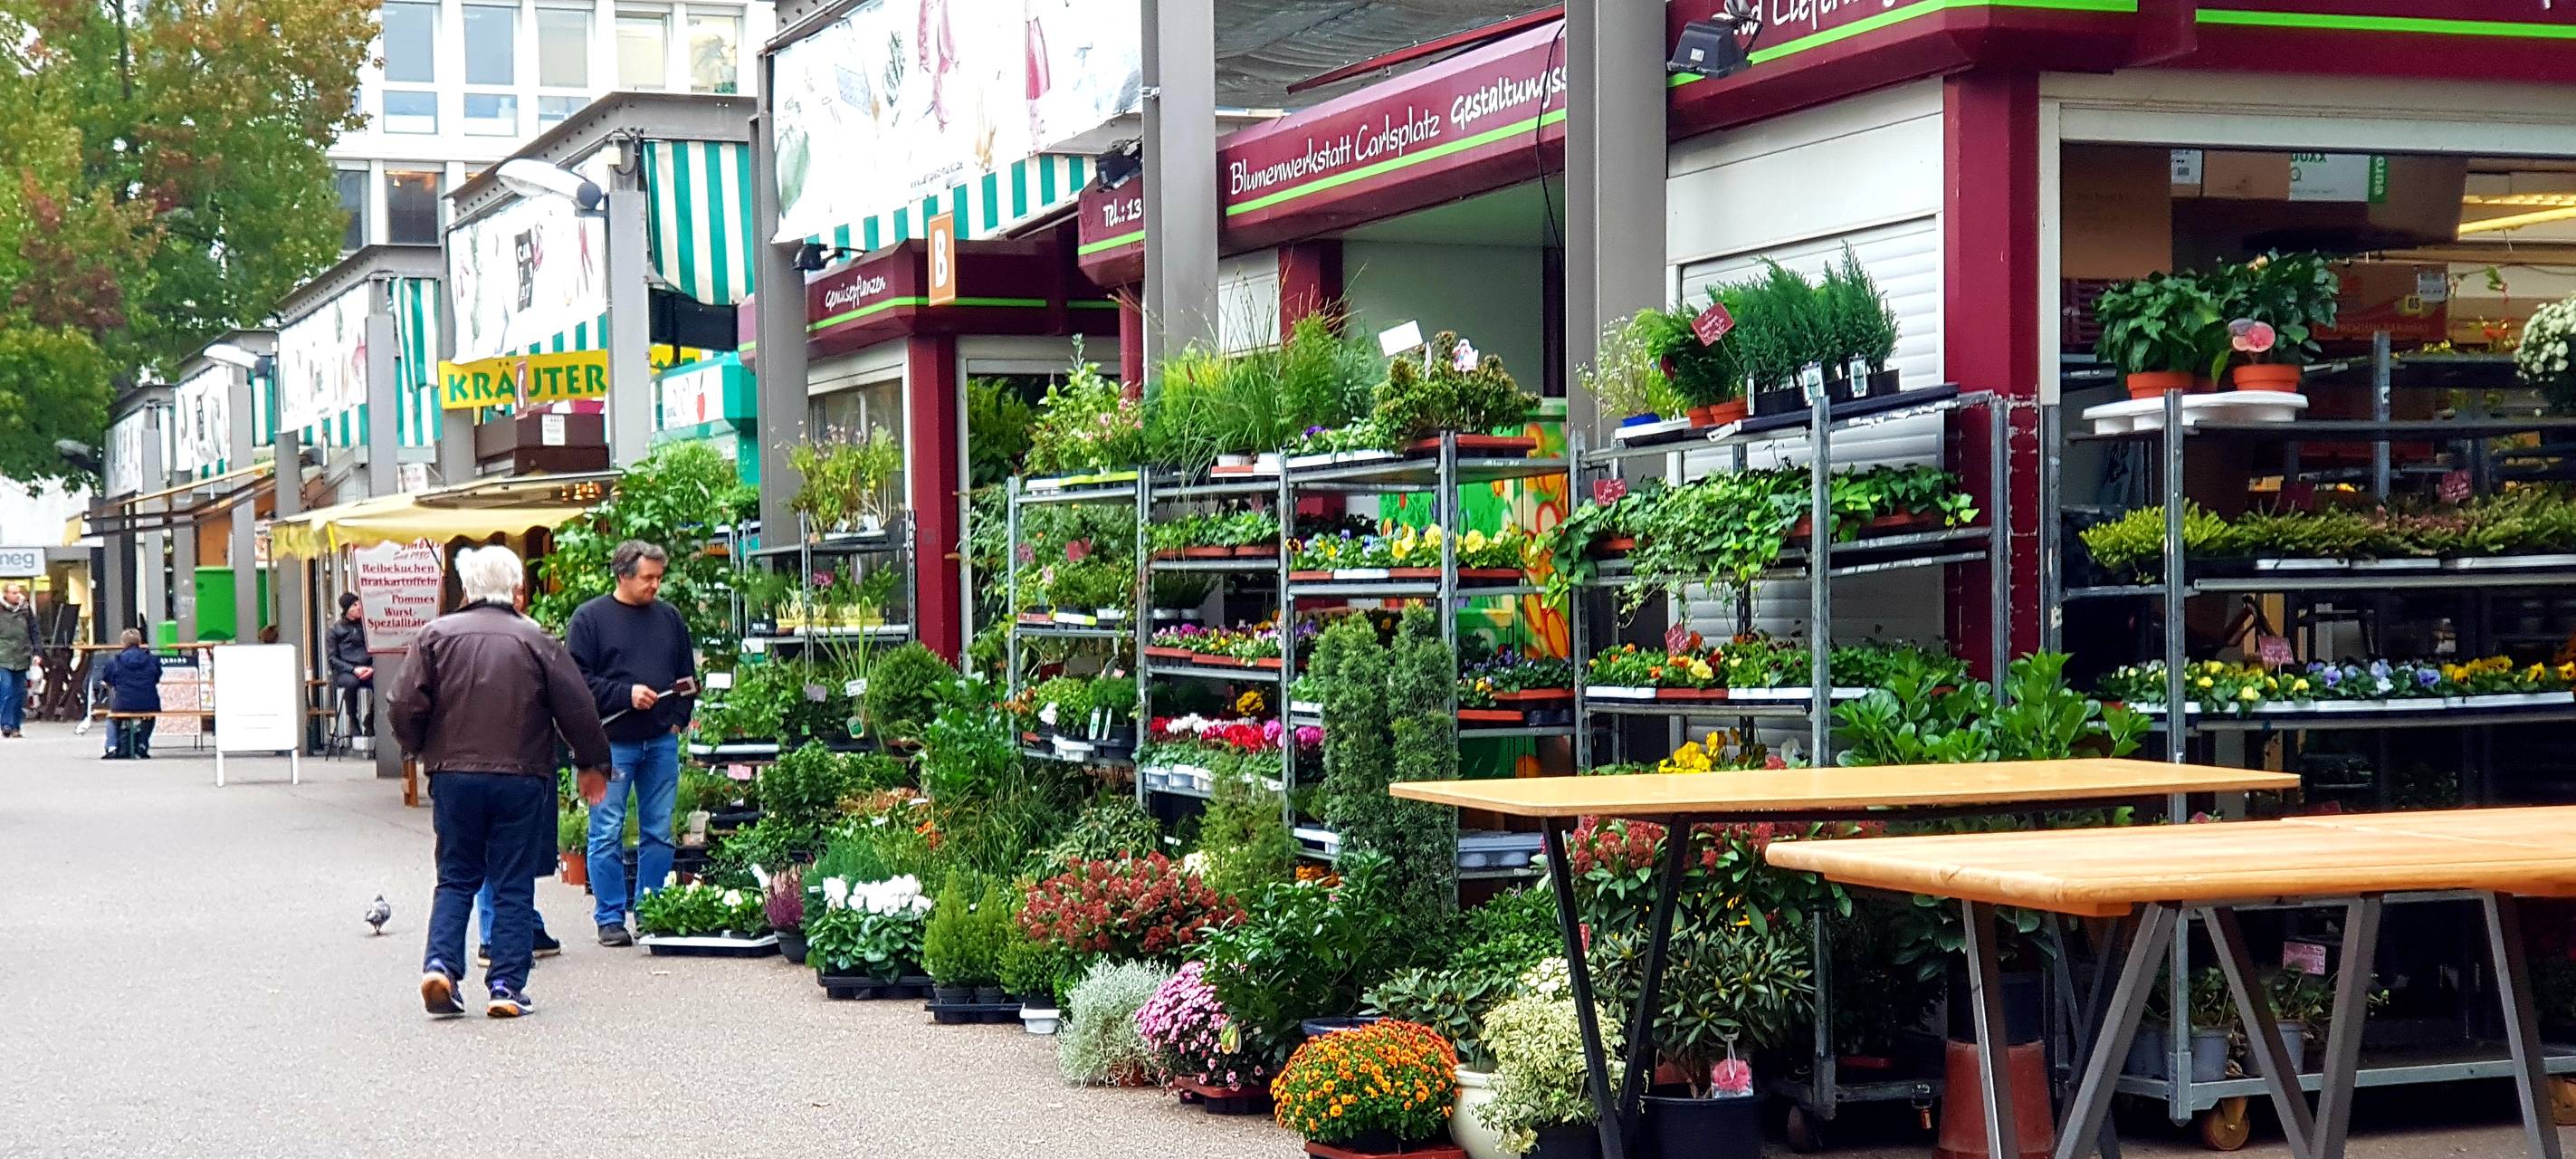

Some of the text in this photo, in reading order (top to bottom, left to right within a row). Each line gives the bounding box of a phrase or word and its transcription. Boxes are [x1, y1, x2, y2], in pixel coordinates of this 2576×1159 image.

[1229, 137, 1352, 196] Blumenwerkstatt
[1354, 104, 1441, 160] Carlsplatz
[934, 228, 948, 289] B
[448, 360, 607, 404] KRÄUTER
[362, 563, 434, 574] Reibekuchen
[391, 594, 434, 604] Pommes
